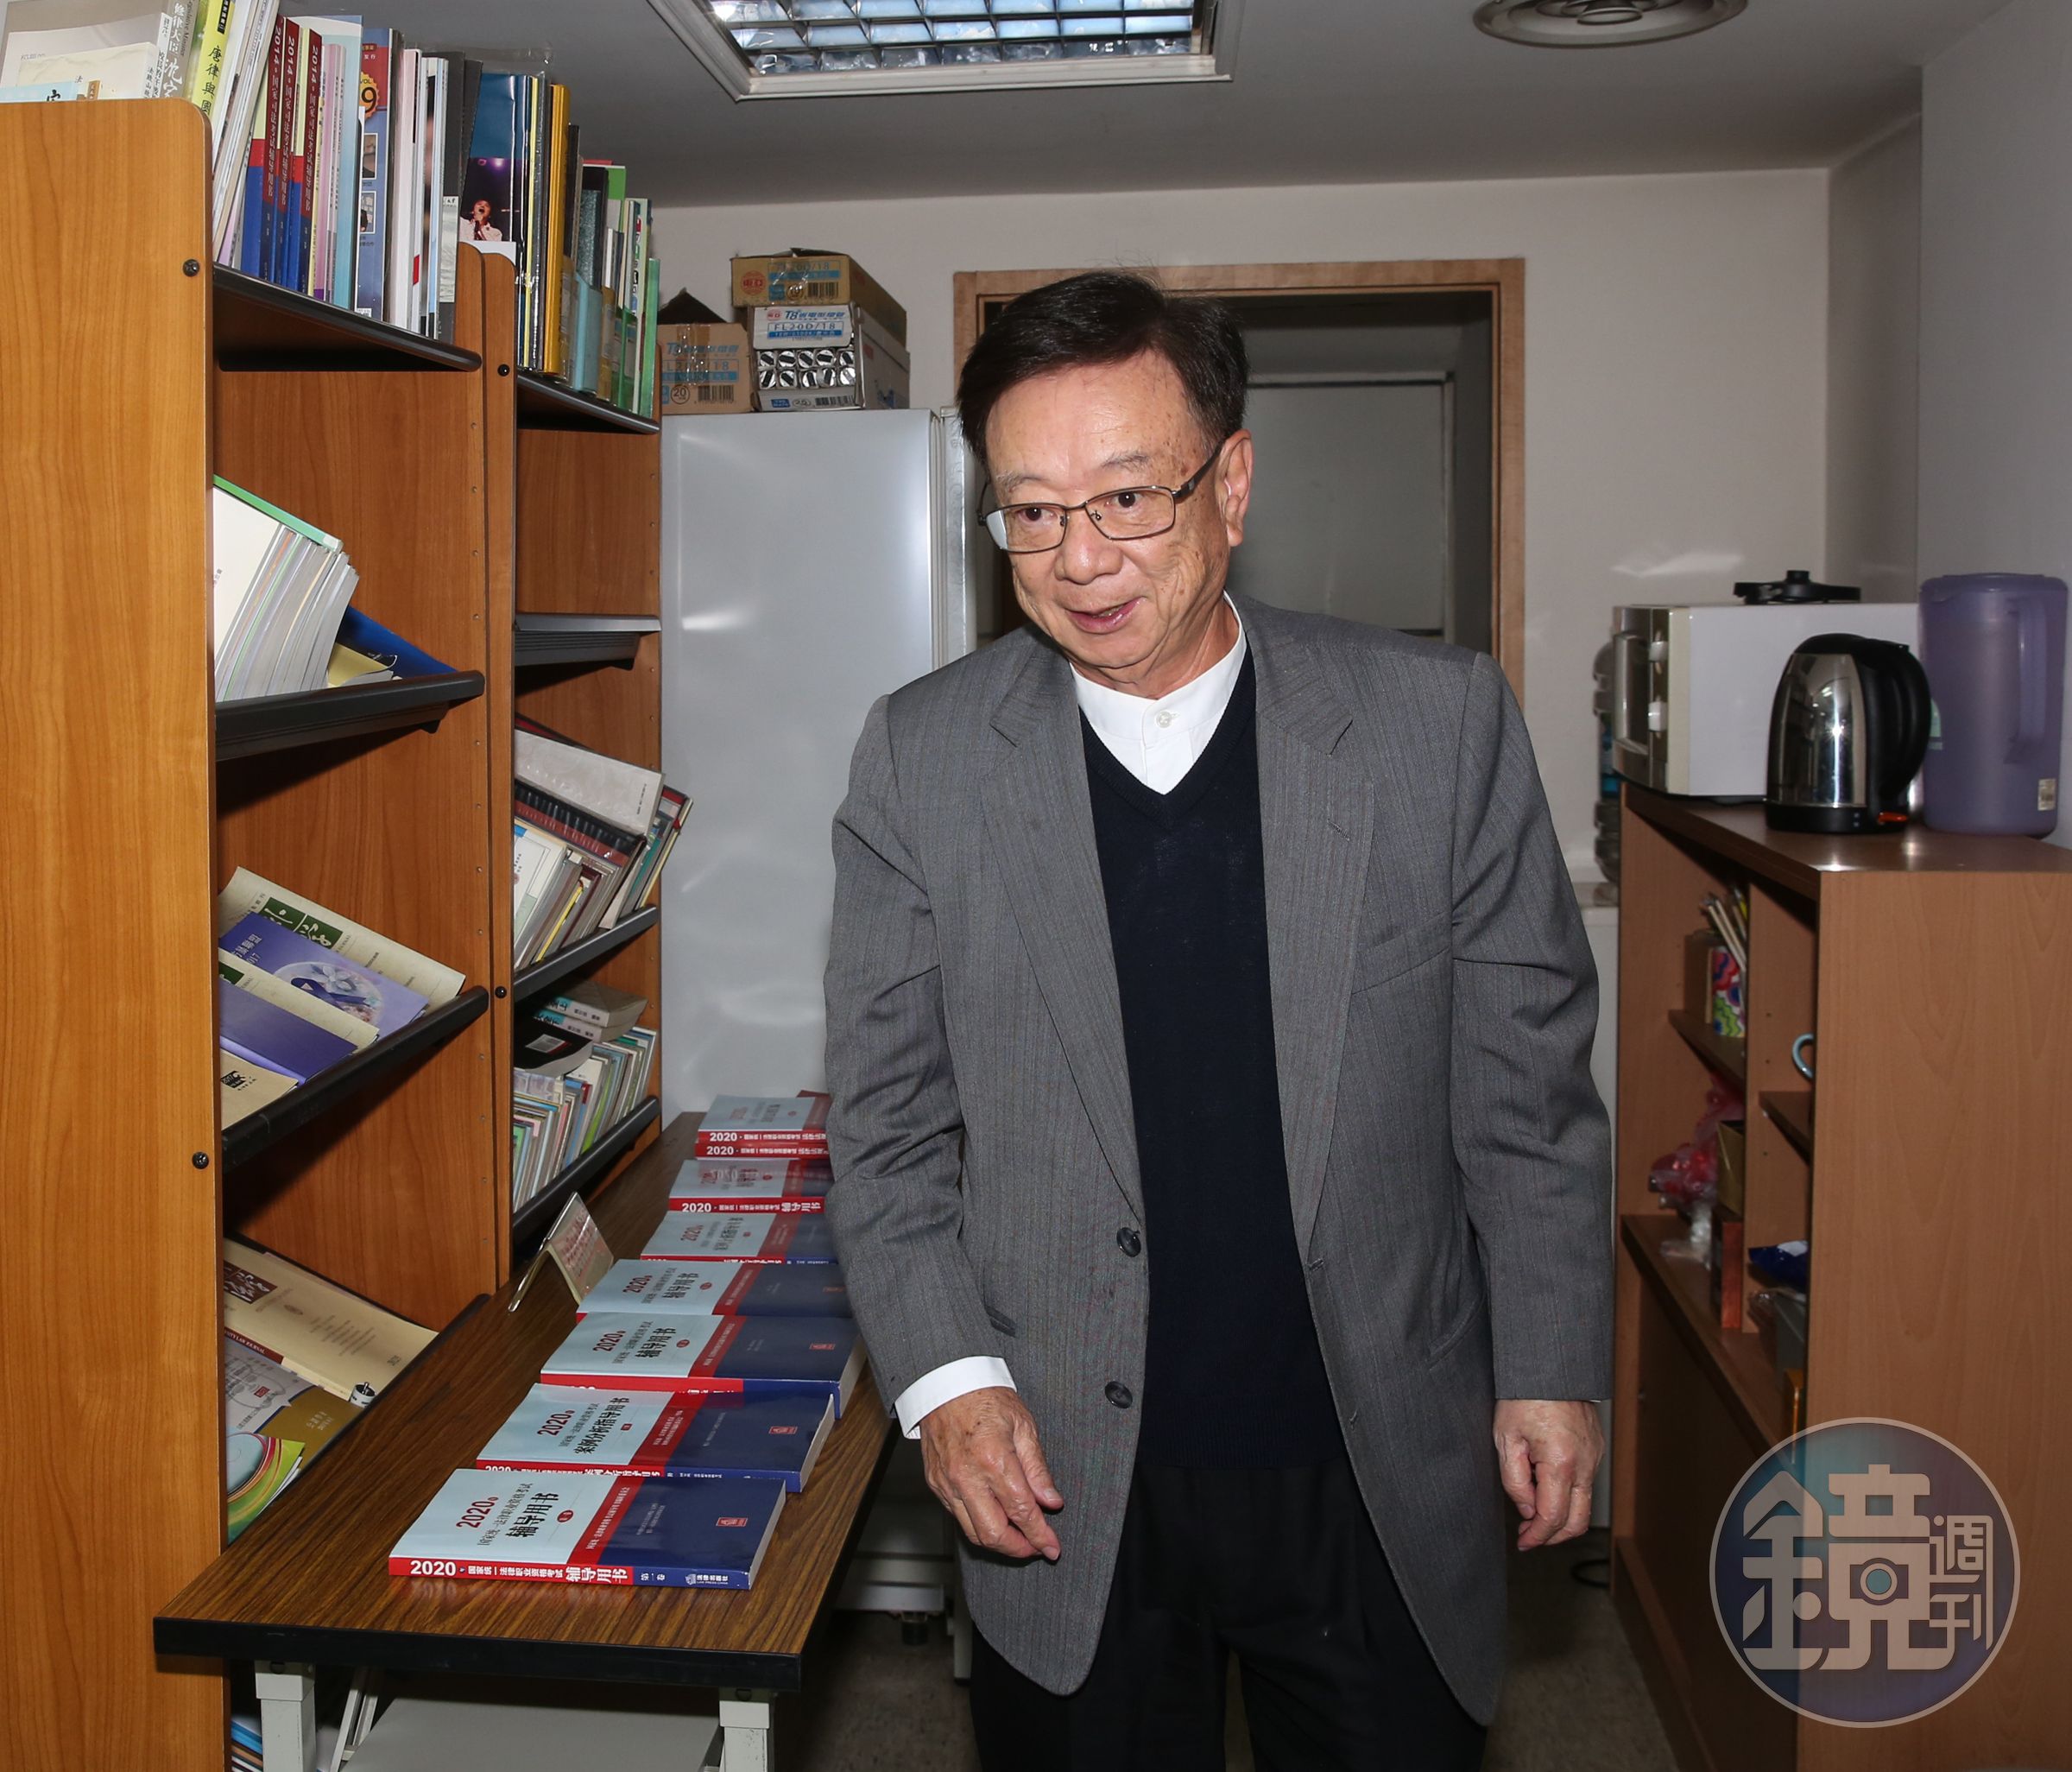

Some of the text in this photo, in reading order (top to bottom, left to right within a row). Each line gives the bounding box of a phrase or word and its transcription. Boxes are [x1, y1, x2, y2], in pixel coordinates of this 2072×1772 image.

[286, 35, 295, 75] 2014
[673, 388, 687, 397] 20
[710, 1132, 738, 1142] 2020
[706, 1146, 734, 1155] 2020
[682, 1203, 711, 1212] 2020
[537, 1413, 572, 1436] 2020
[573, 1397, 631, 1454] 案例分析指导用书
[457, 1501, 496, 1528] 2020
[506, 1493, 559, 1537] 辅导用书
[410, 1560, 457, 1576] 2020
[468, 1566, 564, 1579] 国家统一法律职业资格考试
[565, 1566, 629, 1584] 辅导用书
